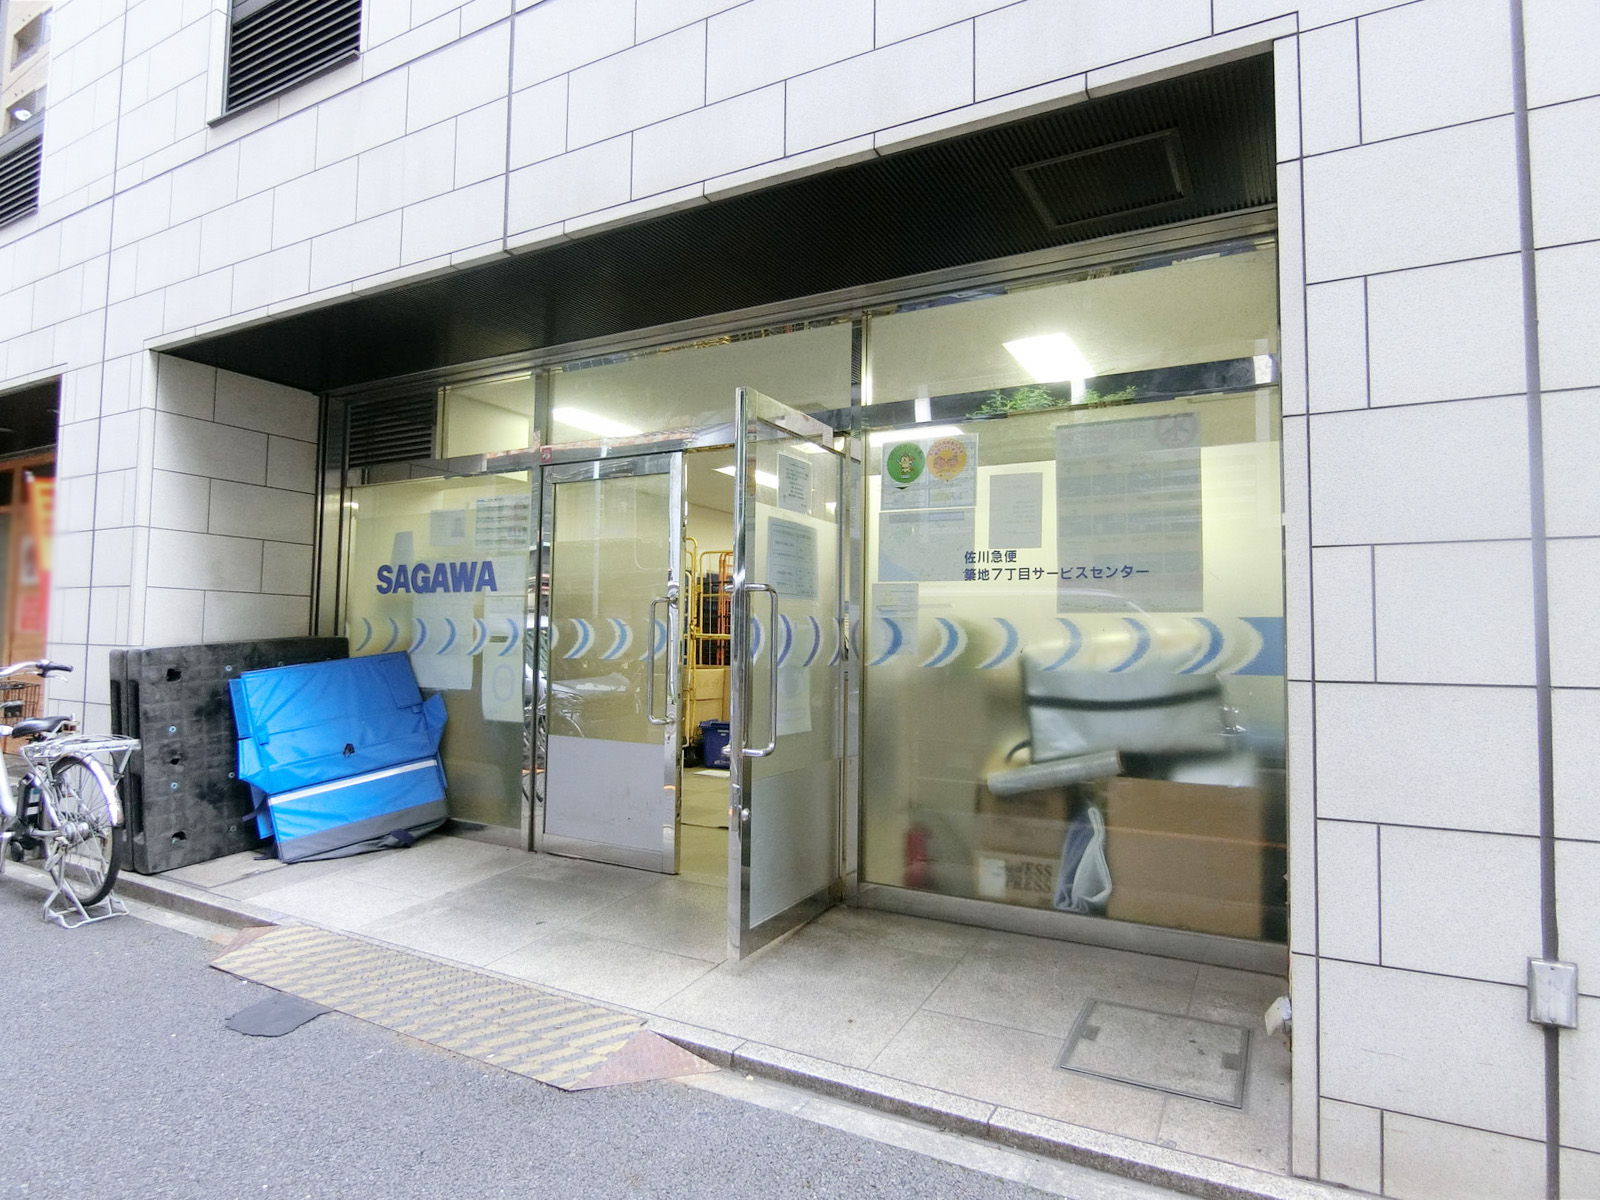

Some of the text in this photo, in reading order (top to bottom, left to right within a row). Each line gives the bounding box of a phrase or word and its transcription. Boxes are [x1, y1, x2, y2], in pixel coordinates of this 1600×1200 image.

[964, 550, 1017, 564] 佐川急便
[376, 561, 498, 594] SAGAWA
[964, 565, 1150, 581] 築地7丁目サービスセンター
